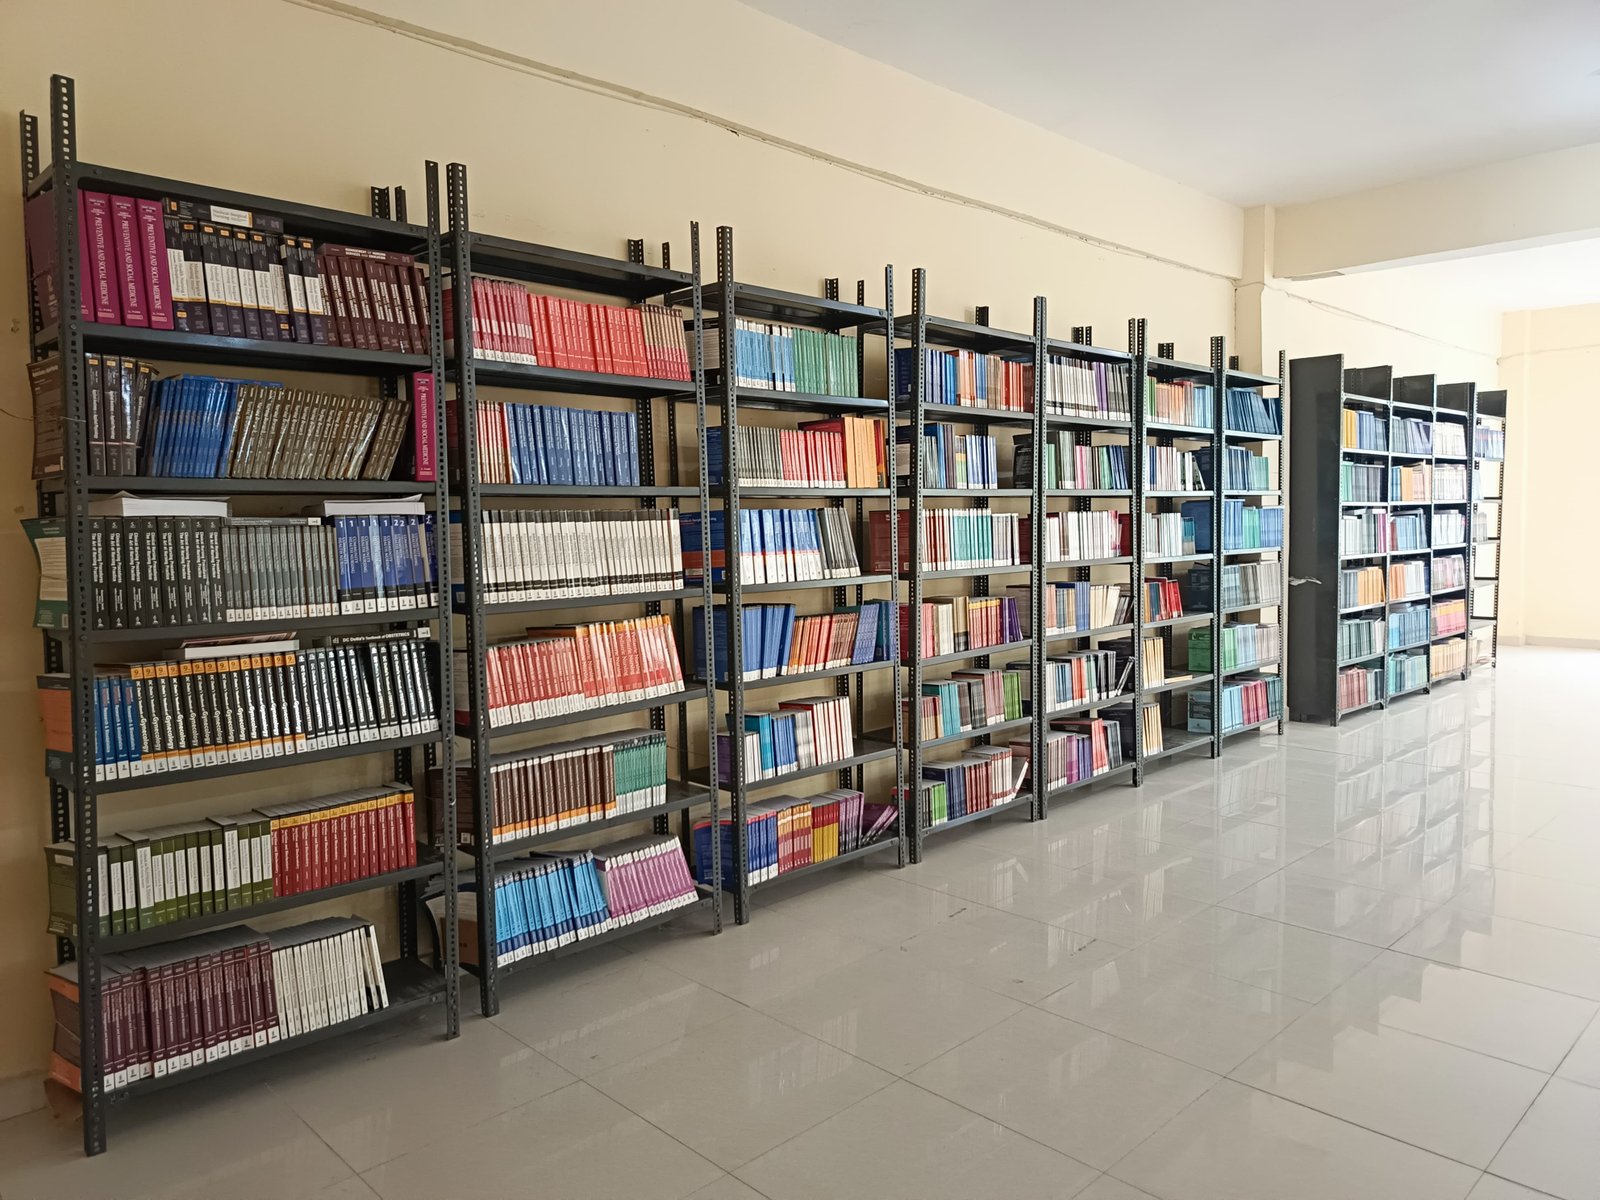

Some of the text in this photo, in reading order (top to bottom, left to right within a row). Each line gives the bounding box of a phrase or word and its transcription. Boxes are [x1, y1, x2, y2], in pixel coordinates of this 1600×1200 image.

[95, 217, 103, 247] PREVENTIVE
[100, 280, 108, 305] MEDICINE
[122, 220, 131, 250] PREVENTIVE
[128, 283, 137, 307] MEDICINE
[147, 223, 156, 253] PREVENTIVE
[153, 285, 161, 309] MEDICINE
[140, 718, 150, 752] Gynecology
[152, 717, 162, 751] Gynecology
[165, 716, 174, 749] Gynecology
[177, 715, 187, 748] Gynecology
[189, 713, 199, 746] Gynecology
[201, 712, 211, 744] Gynecology
[213, 711, 223, 744] Gynecology
[226, 710, 235, 742] Gynecology
[237, 708, 246, 740] Gynecology
[248, 706, 258, 738] Gynecology
[260, 705, 269, 737] Gynecology
